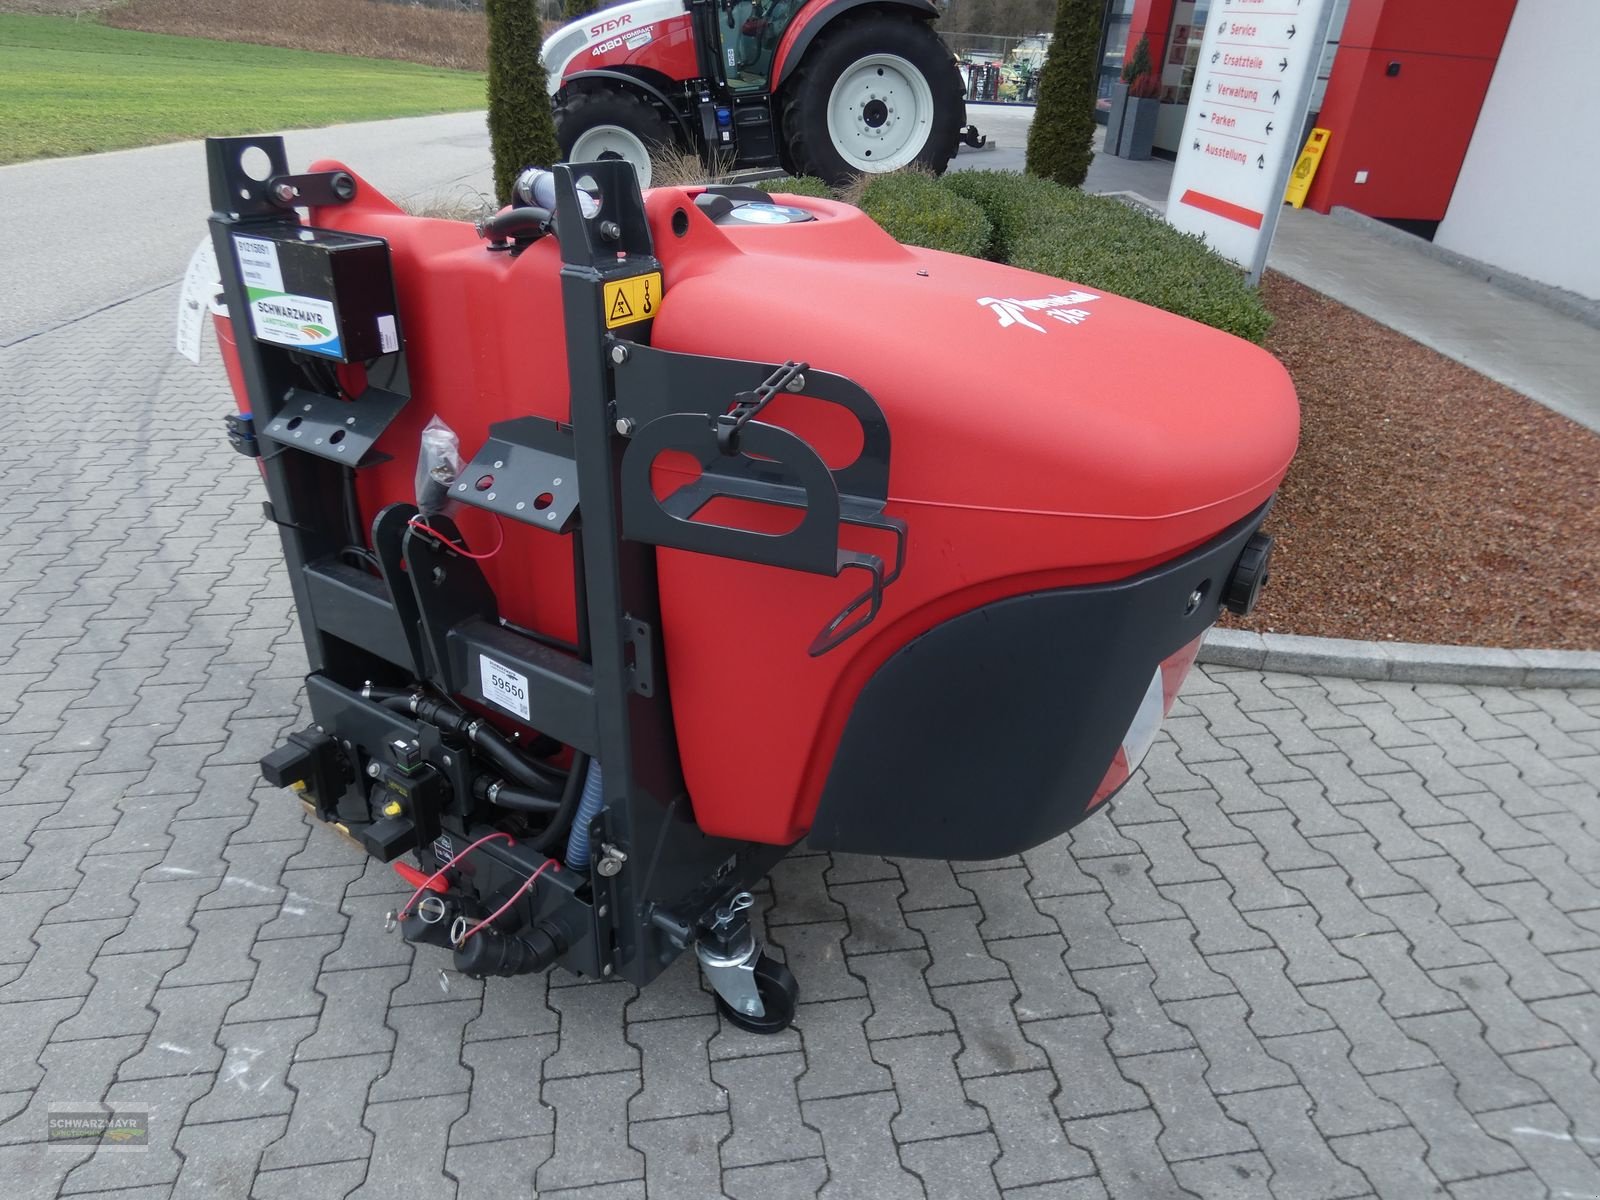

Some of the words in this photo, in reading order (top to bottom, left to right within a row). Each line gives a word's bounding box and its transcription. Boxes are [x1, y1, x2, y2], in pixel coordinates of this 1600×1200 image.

[590, 14, 632, 38] STEYR
[1230, 23, 1257, 37] Service
[592, 37, 623, 57] 4080
[621, 25, 654, 41] KOMPAKT
[1223, 53, 1263, 70] Ersatzteile
[1217, 83, 1258, 102] Verwaltung
[1210, 112, 1236, 128] Parken
[1204, 143, 1247, 166] Ausstellung
[257, 301, 324, 325] SCHWARZMAYR
[491, 674, 524, 700] 59550
